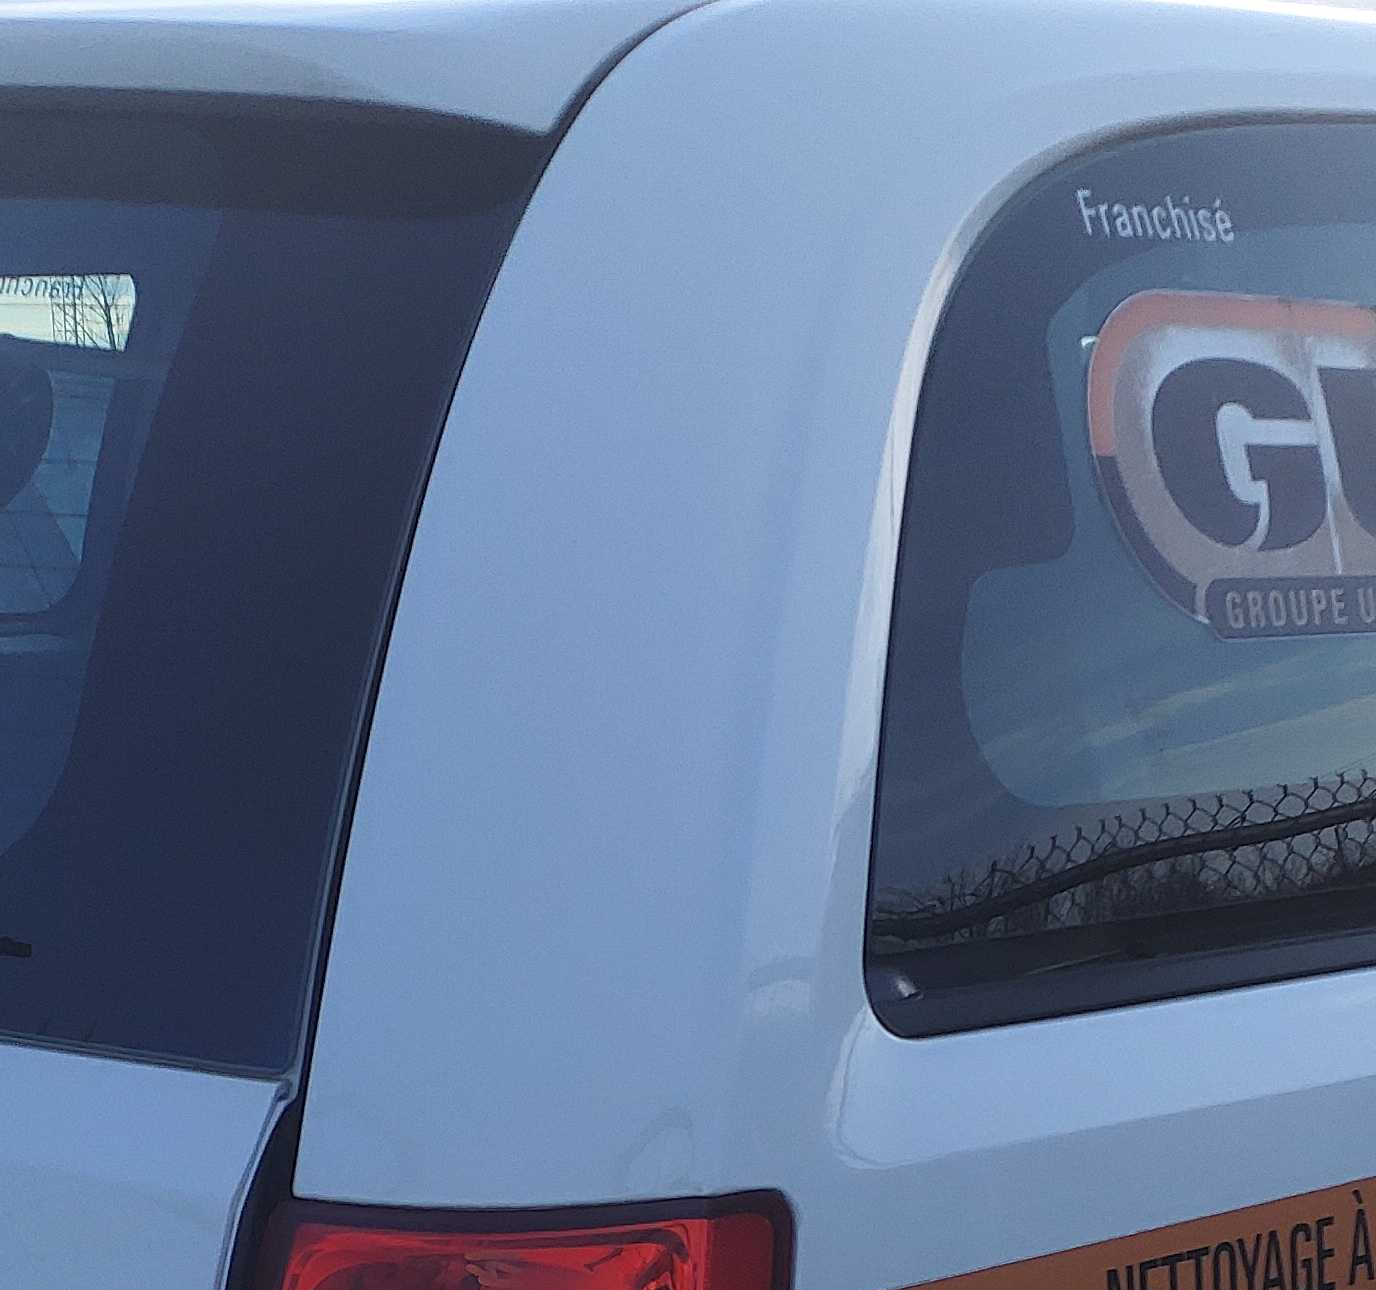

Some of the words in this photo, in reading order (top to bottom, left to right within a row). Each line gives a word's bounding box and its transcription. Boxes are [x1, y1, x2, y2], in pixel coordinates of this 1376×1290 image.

[1077, 189, 1234, 242] Franchisé
[1226, 588, 1349, 629] GROUPE
[1349, 1190, 1375, 1285] À
